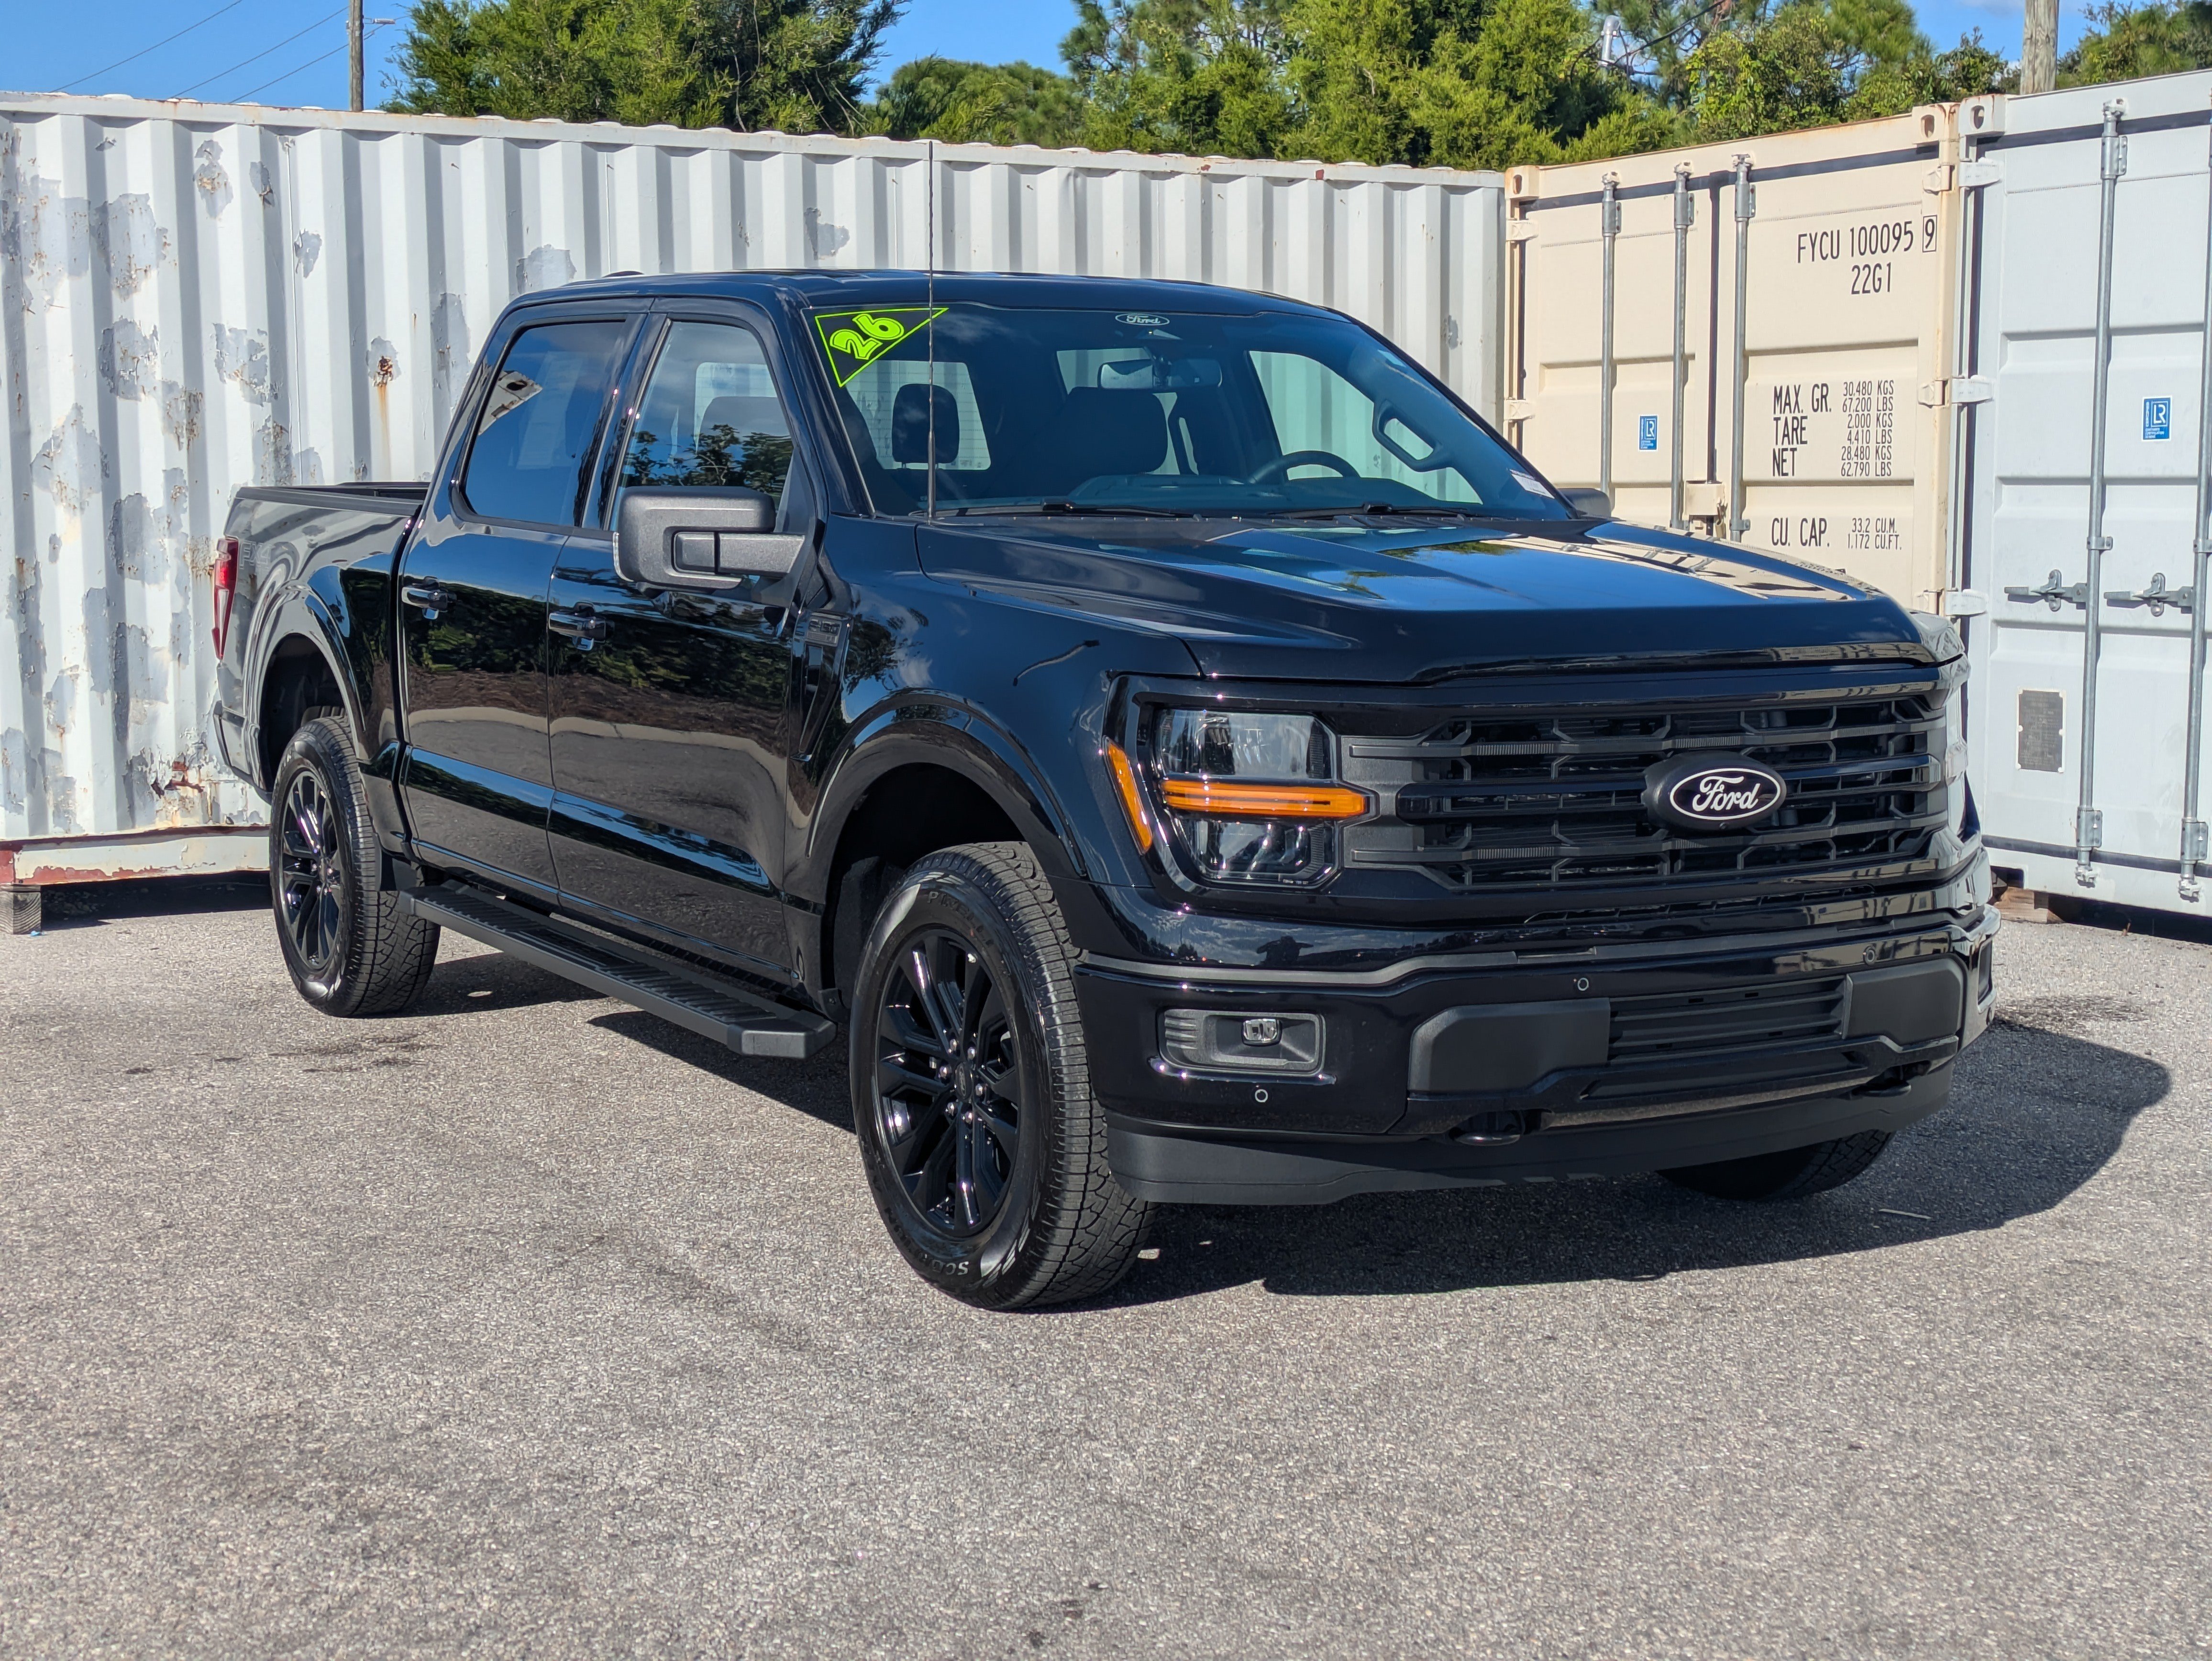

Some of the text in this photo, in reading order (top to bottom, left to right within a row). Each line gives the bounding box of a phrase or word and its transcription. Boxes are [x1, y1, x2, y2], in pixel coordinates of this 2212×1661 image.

[1798, 219, 1935, 263] FYCU 100095 9
[1851, 262, 1891, 294] 22G1
[1127, 315, 1160, 324] Ford
[830, 313, 904, 360] 26
[1773, 383, 1832, 414] MAX. GR.
[1878, 380, 1893, 396] KGS
[1877, 396, 1893, 411] LBS
[1773, 416, 1807, 445] TARE
[1876, 412, 1892, 428] KGS
[1876, 429, 1892, 444] LBS
[1773, 447, 1797, 476] NET
[1875, 445, 1891, 460] KGS
[1875, 462, 1891, 476] LBS
[1771, 518, 1830, 547] CU. CAP.
[1852, 517, 1897, 533] 33.2 CU.M.
[1692, 775, 1760, 811] Ford
